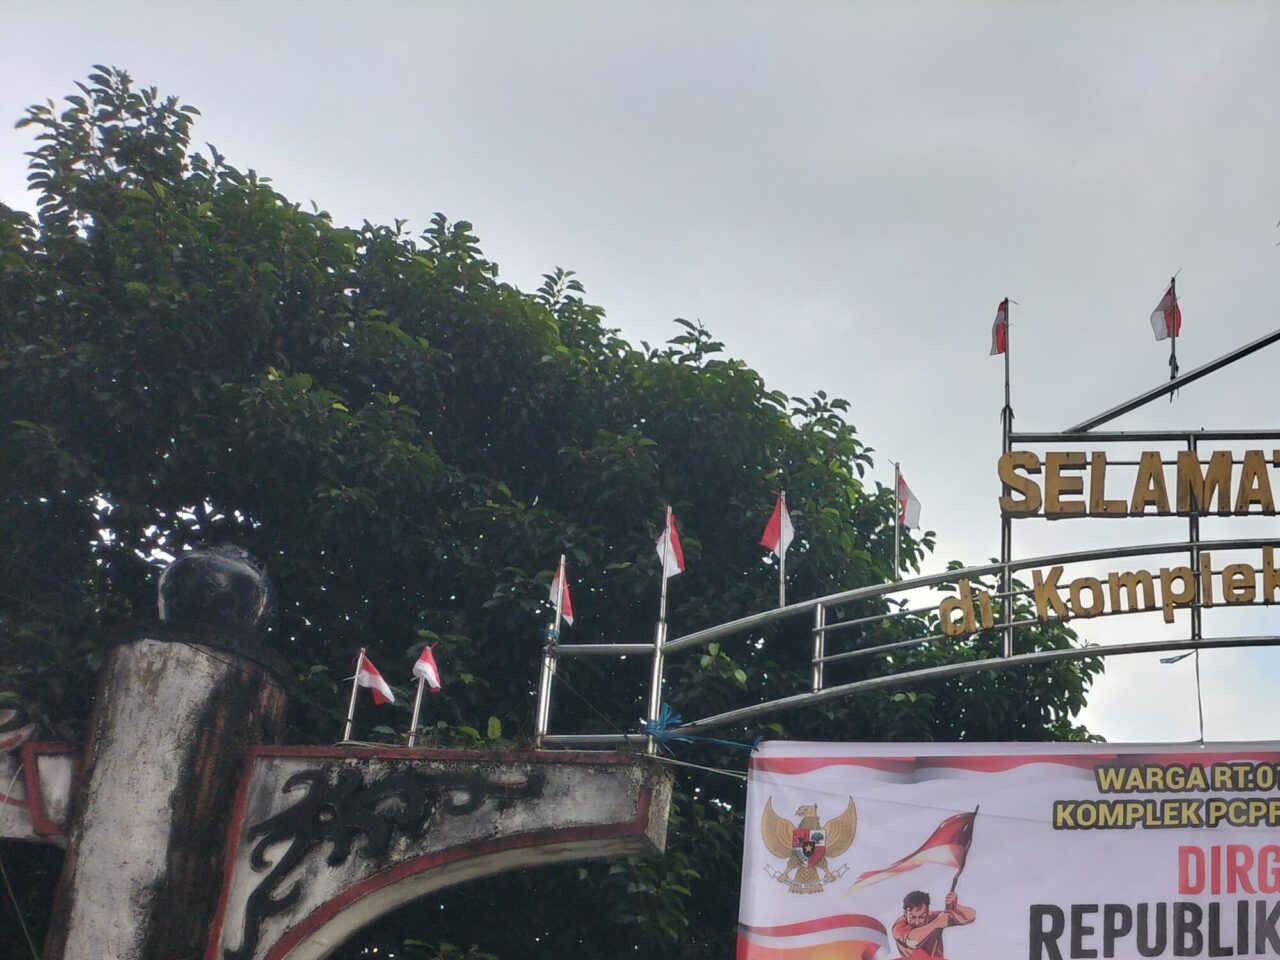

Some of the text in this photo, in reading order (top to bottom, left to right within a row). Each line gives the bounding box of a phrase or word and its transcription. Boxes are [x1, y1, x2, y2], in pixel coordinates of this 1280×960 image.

[938, 578, 994, 636] di
[1095, 764, 1209, 793] WARGA
[1053, 800, 1203, 829] KOMPLEK
